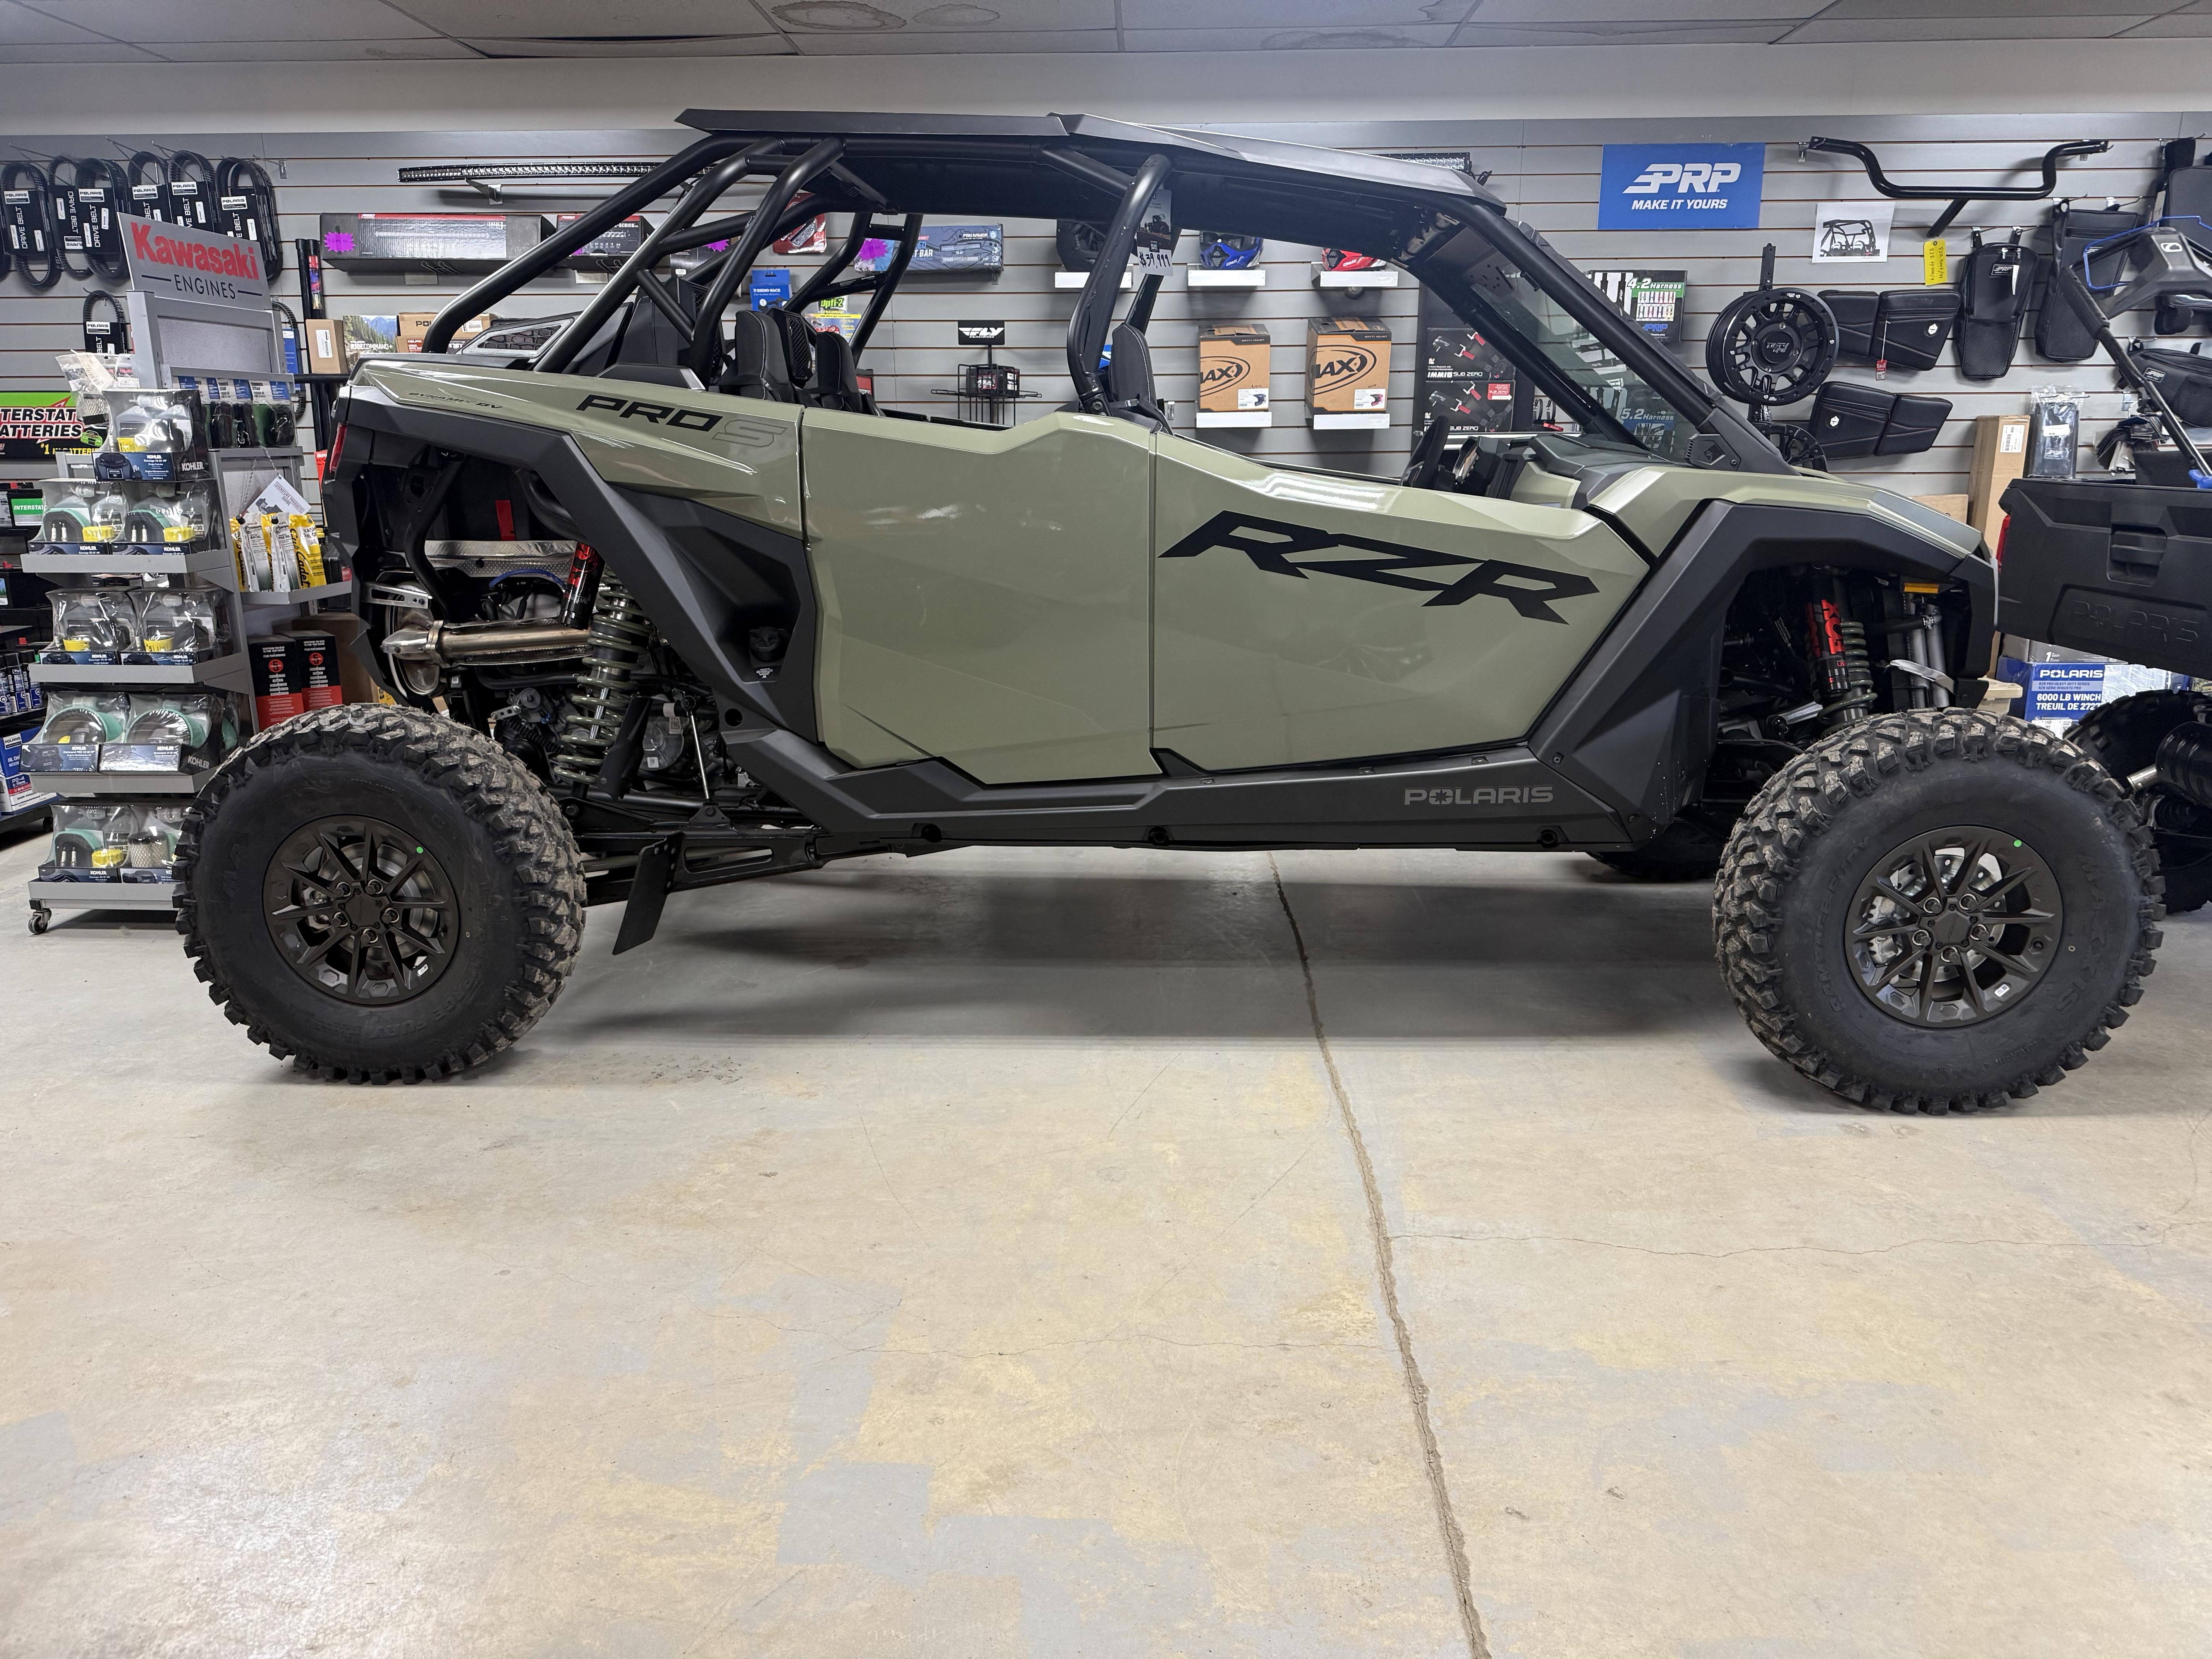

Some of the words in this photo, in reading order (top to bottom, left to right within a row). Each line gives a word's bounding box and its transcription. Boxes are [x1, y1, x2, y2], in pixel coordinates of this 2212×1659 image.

[1623, 163, 1741, 194] PRP
[68, 191, 76, 213] DRIVE
[182, 197, 191, 215] BELT
[1632, 200, 1668, 210] MAKE
[1671, 200, 1684, 210] IT
[1686, 199, 1728, 210] YOURS
[15, 206, 24, 224] BELT
[89, 204, 98, 223] BELT
[232, 212, 242, 230] BELT
[19, 227, 28, 249] DRIVE
[91, 225, 101, 247] DRIVE
[131, 222, 259, 280] Kawasaki
[919, 249, 933, 257] BAR
[1139, 252, 1171, 269] $39,999
[174, 274, 235, 299] ENGINES
[1627, 277, 1652, 289] 4.2
[958, 328, 1004, 336] FLY
[1642, 323, 1668, 332] PRP
[0, 408, 76, 421] TERSTAT
[576, 394, 723, 432] PRO
[711, 419, 789, 447] S
[1621, 409, 1645, 420] 5.2
[0, 424, 83, 437] ATTERIES
[182, 462, 204, 471] KOHLER
[1157, 510, 1600, 625] RZR
[2040, 670, 2103, 678] POLARIS
[2037, 693, 2058, 701] 6000
[2036, 702, 2066, 711] TREUIL
[2067, 702, 2078, 711] DE
[187, 755, 210, 769] KOHLER
[1404, 786, 1554, 805] POLARIS
